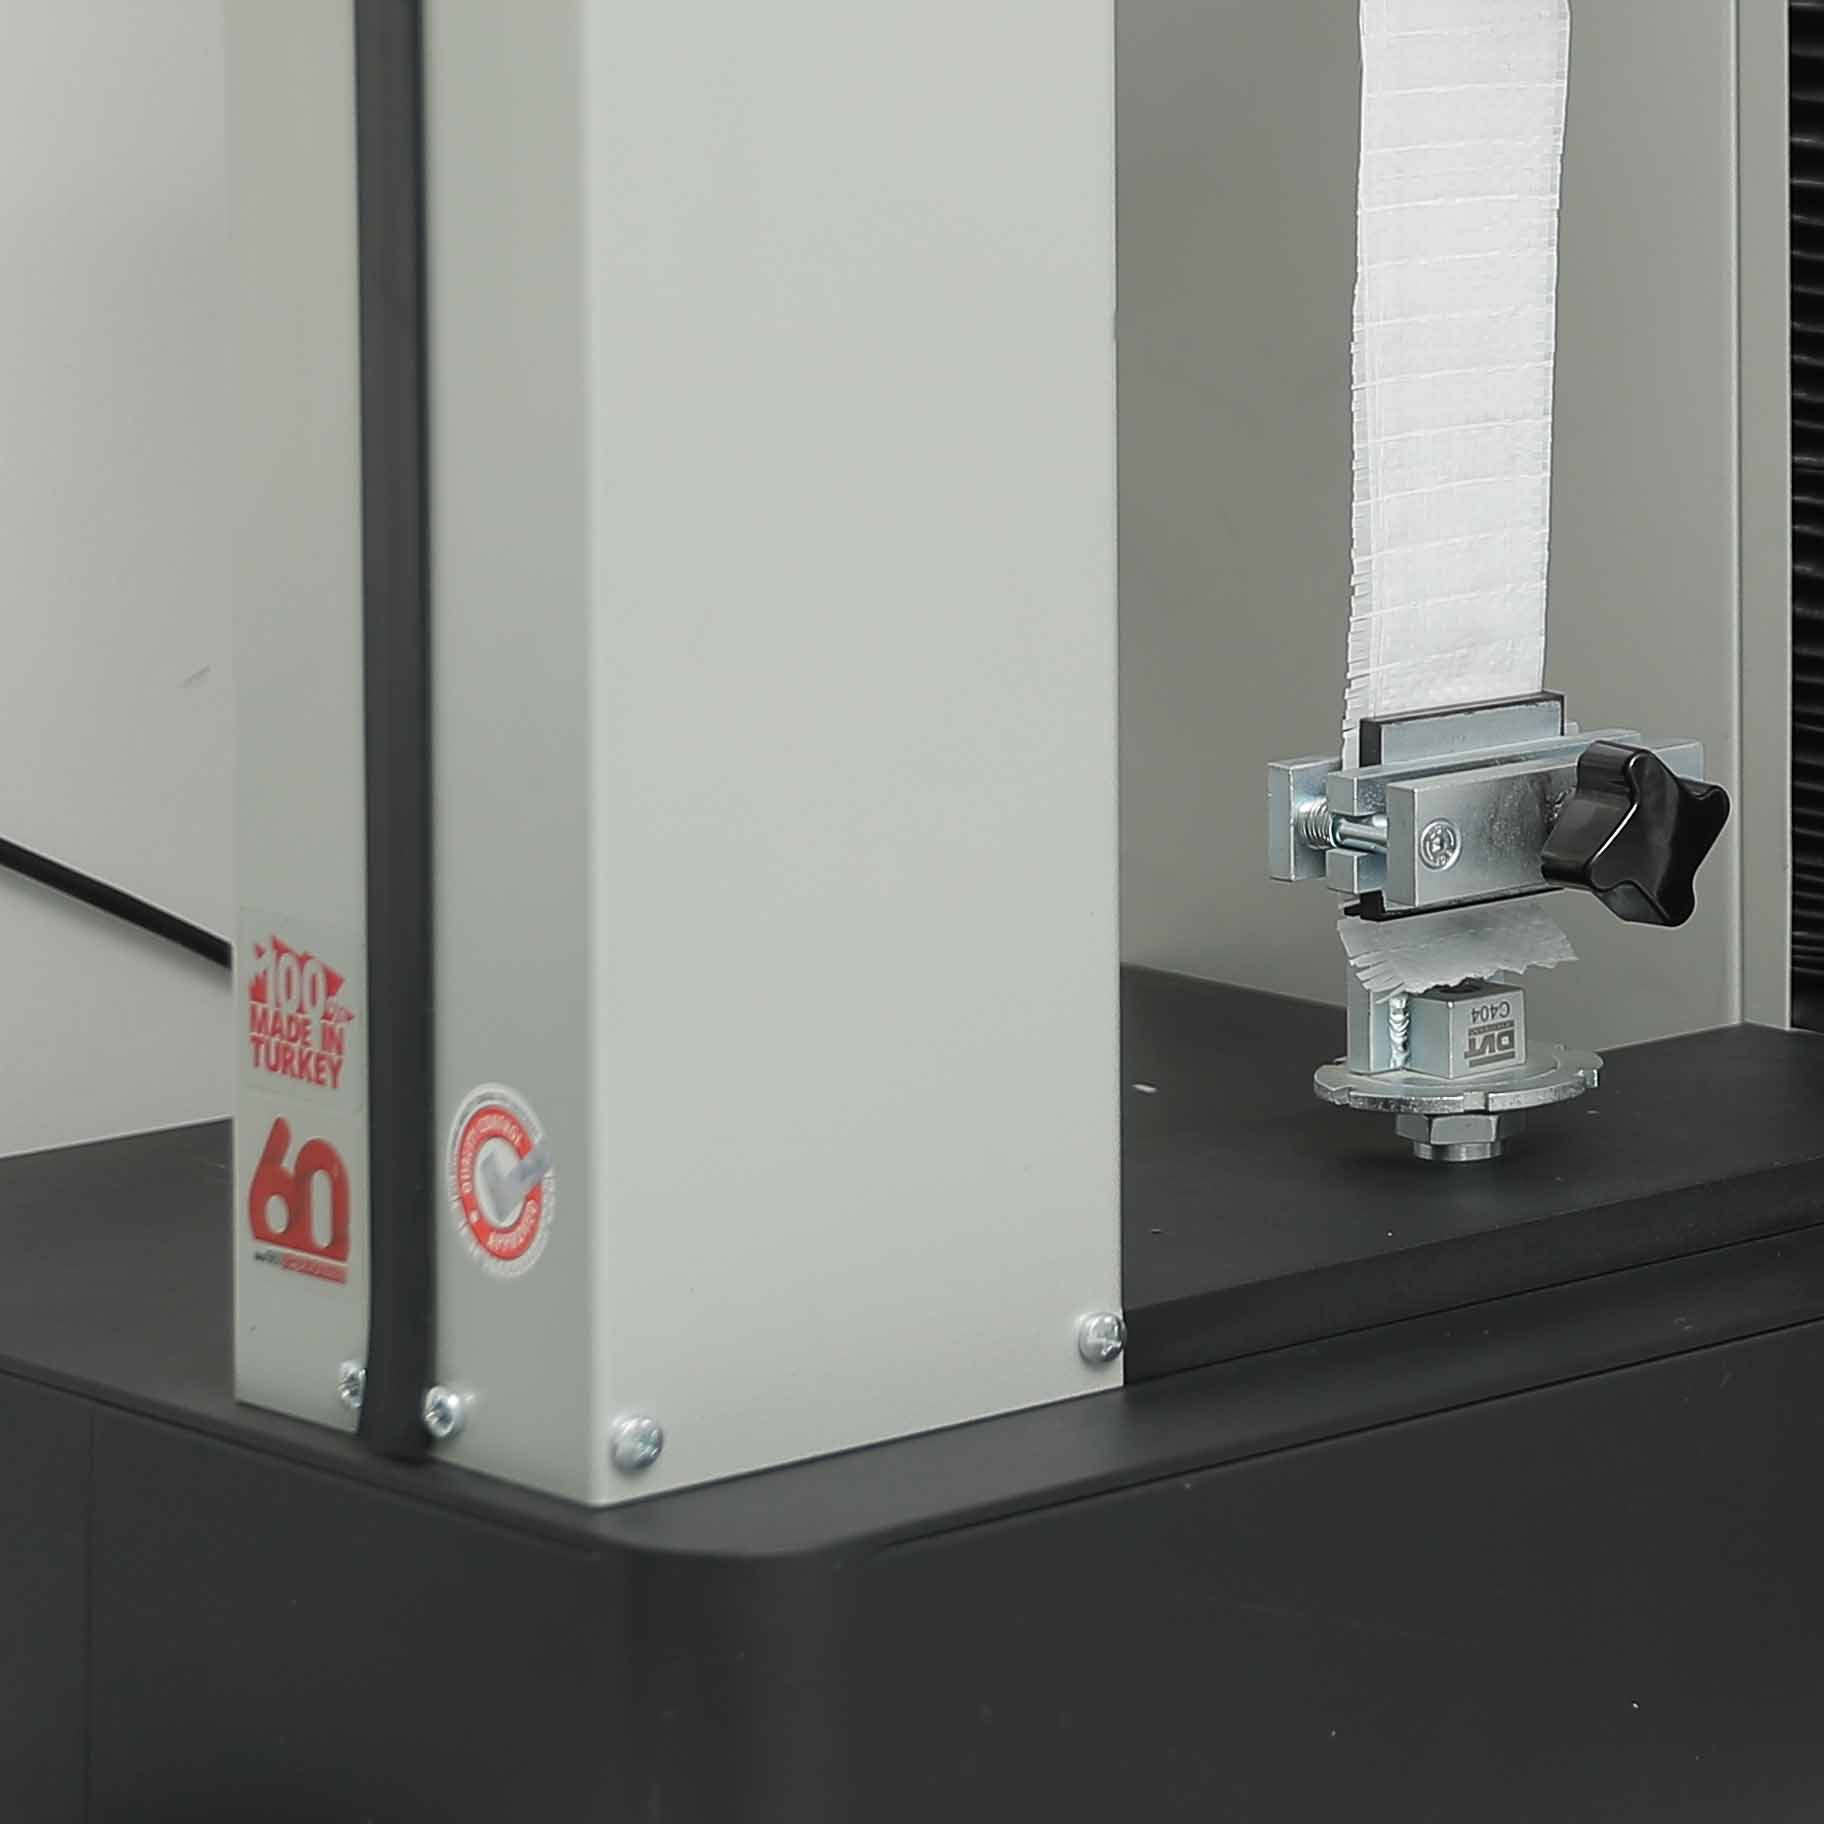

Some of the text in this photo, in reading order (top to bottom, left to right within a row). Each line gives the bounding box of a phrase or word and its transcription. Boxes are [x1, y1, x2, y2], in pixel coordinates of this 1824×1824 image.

[249, 1004, 345, 1055] MADE IN
[1472, 1001, 1510, 1024] C404
[249, 1035, 345, 1089] TURKEY
[248, 1116, 350, 1262] 60
